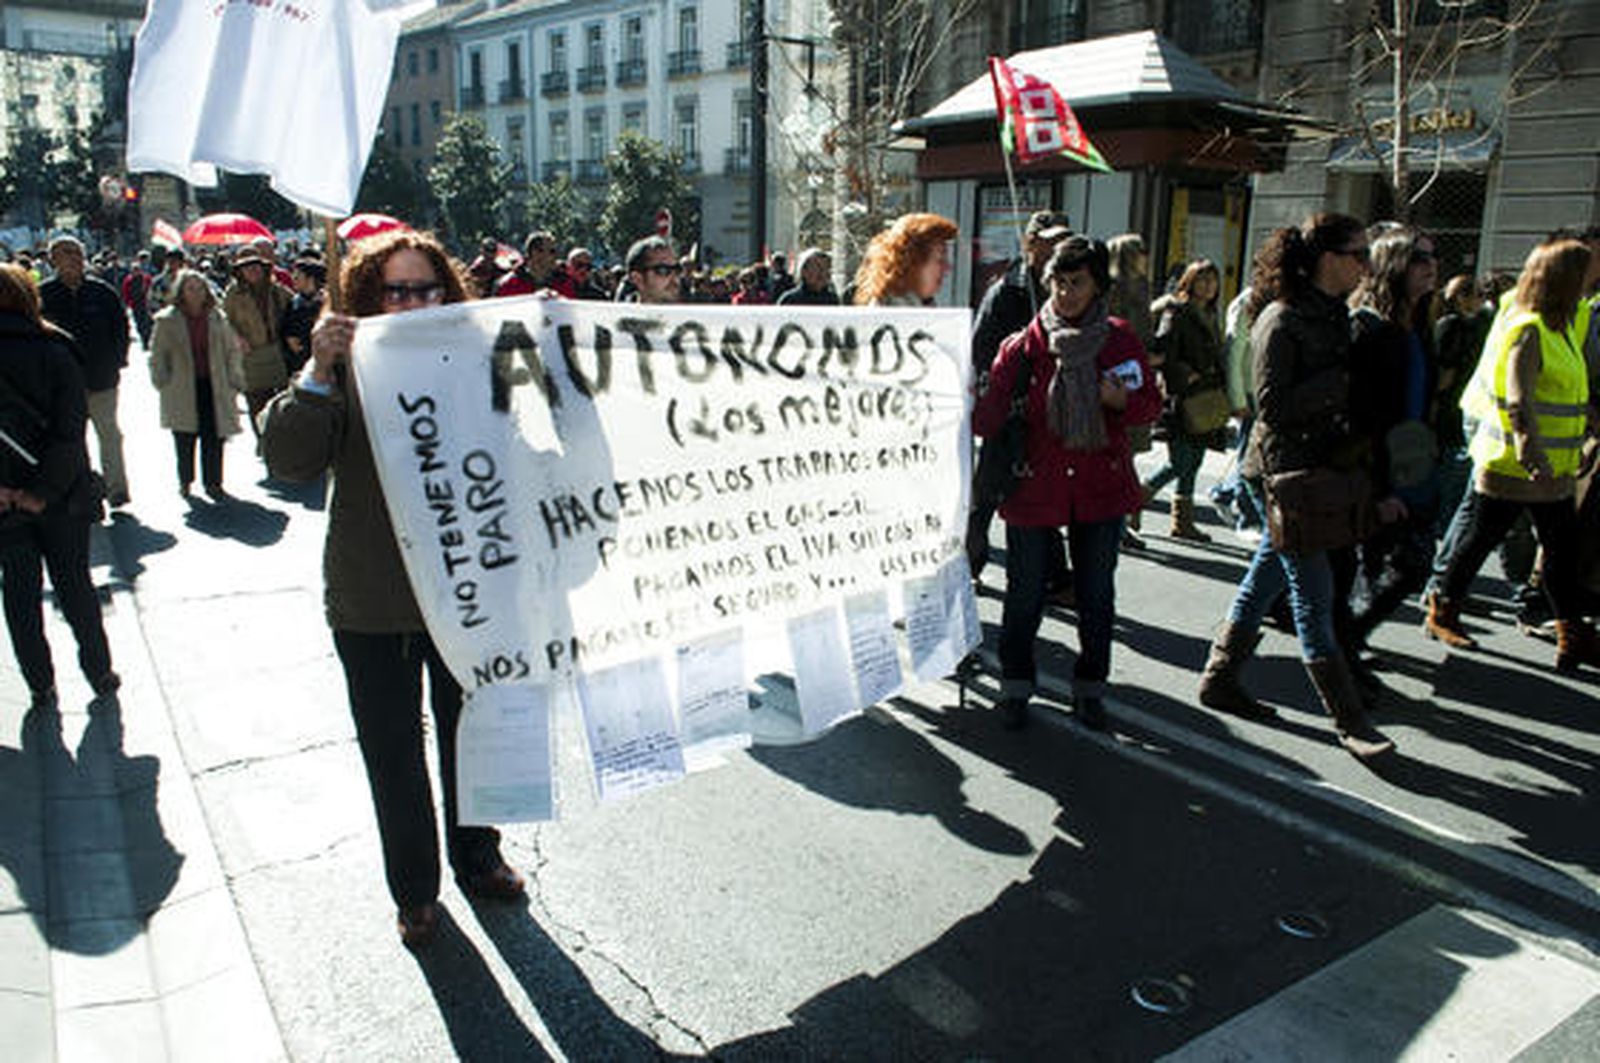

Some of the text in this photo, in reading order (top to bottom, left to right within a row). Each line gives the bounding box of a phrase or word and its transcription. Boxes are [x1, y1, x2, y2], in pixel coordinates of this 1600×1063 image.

[397, 391, 491, 630] NO TENEMOS
[461, 449, 520, 571] PARO
[538, 470, 703, 550] HACEMOS
[706, 463, 755, 495] LOS
[745, 510, 778, 536] EL
[764, 544, 798, 573] EL
[801, 531, 842, 561] IVA
[470, 647, 531, 688] NOS
